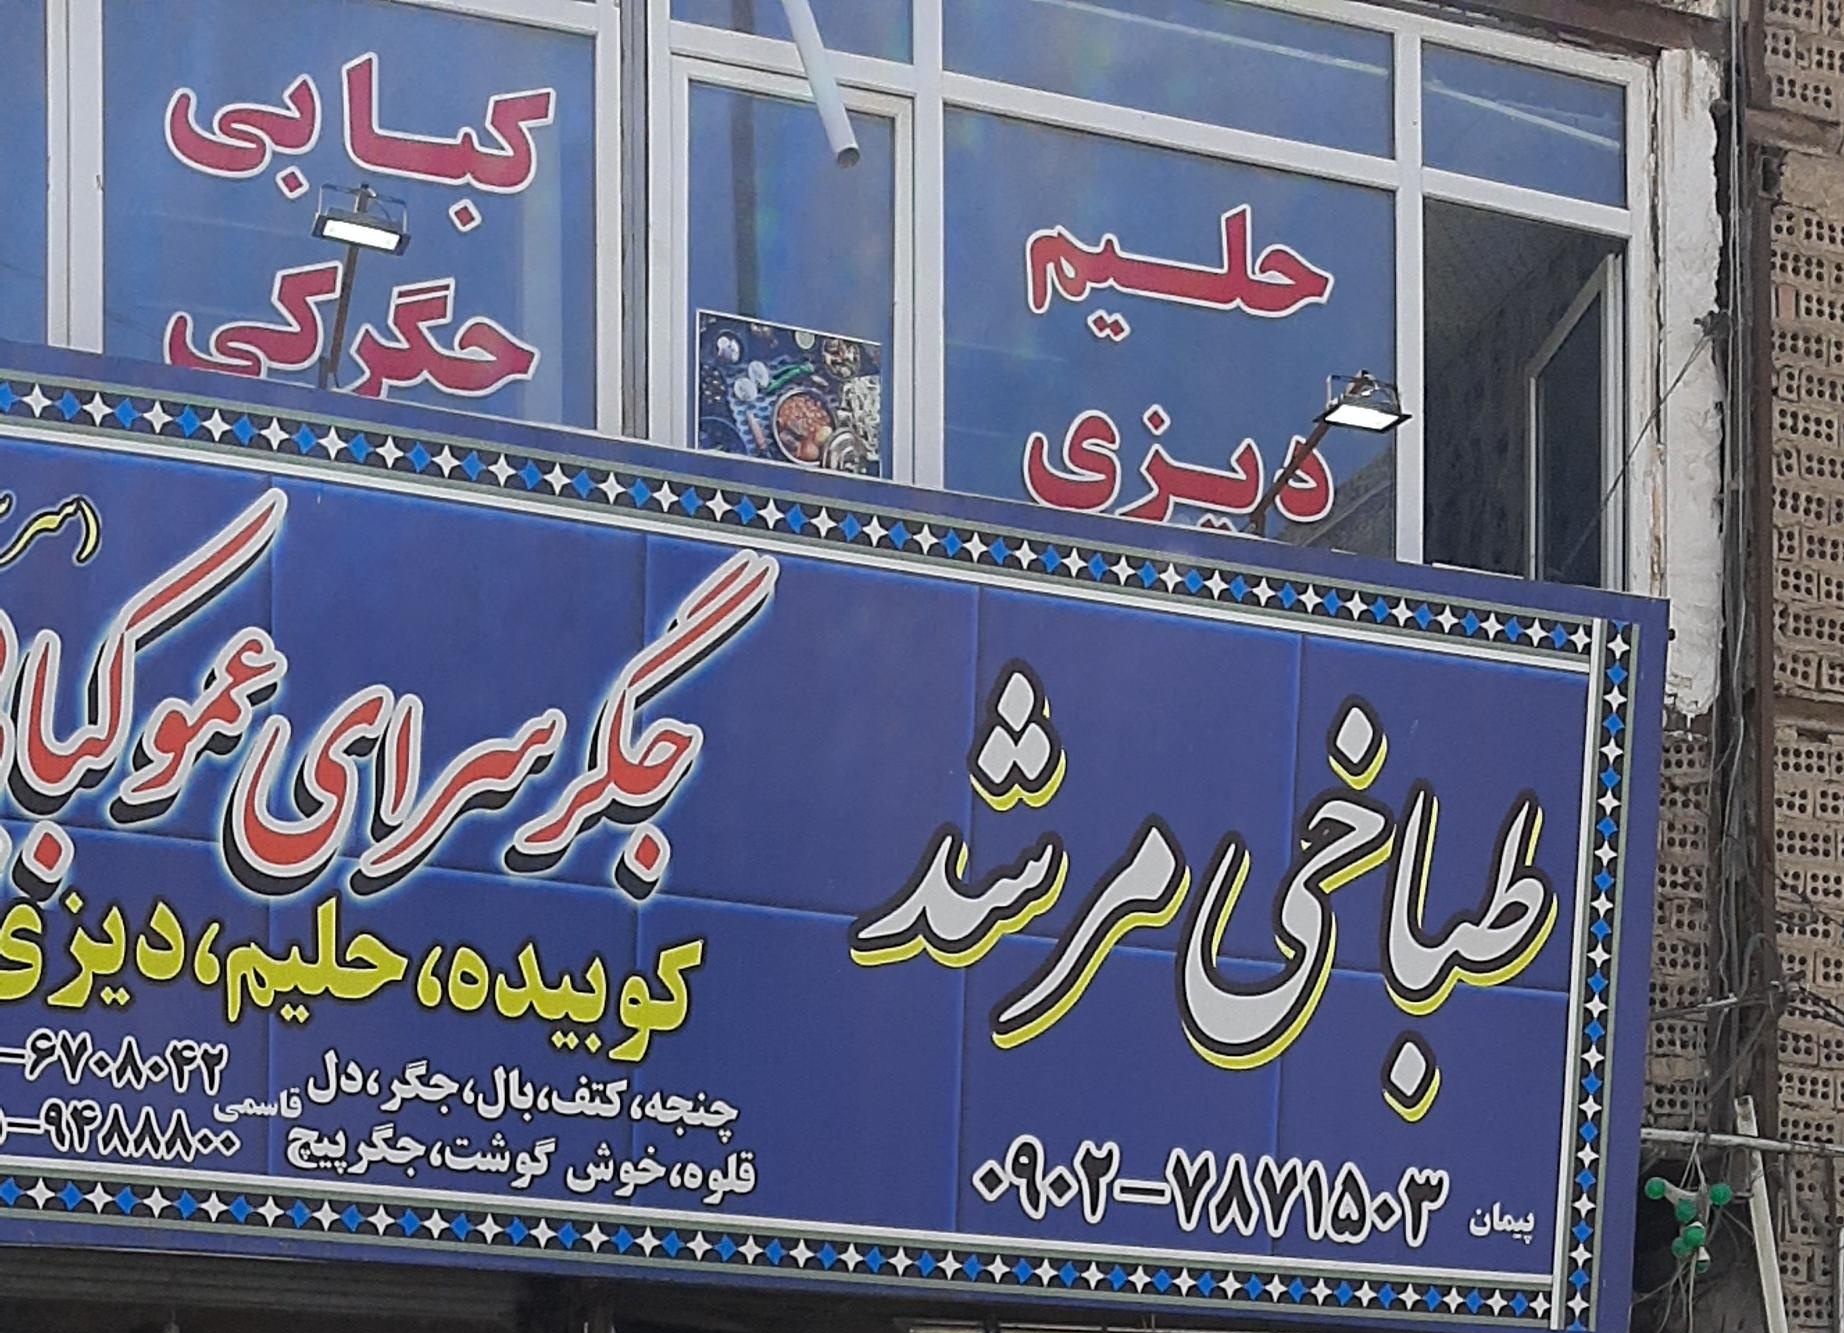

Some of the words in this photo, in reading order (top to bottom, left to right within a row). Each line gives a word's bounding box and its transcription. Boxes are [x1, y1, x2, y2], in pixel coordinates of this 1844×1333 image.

[165, 52, 556, 232] کبابی
[1026, 203, 1334, 341] حلیم
[1023, 405, 1335, 531] دیزی
[849, 657, 1190, 1050] مرشد
[1180, 695, 1558, 1122] طباخی
[213, 1087, 304, 1123] قاسمی
[566, 1142, 667, 1197] خوش
[1468, 1202, 1535, 1246] پیمان
